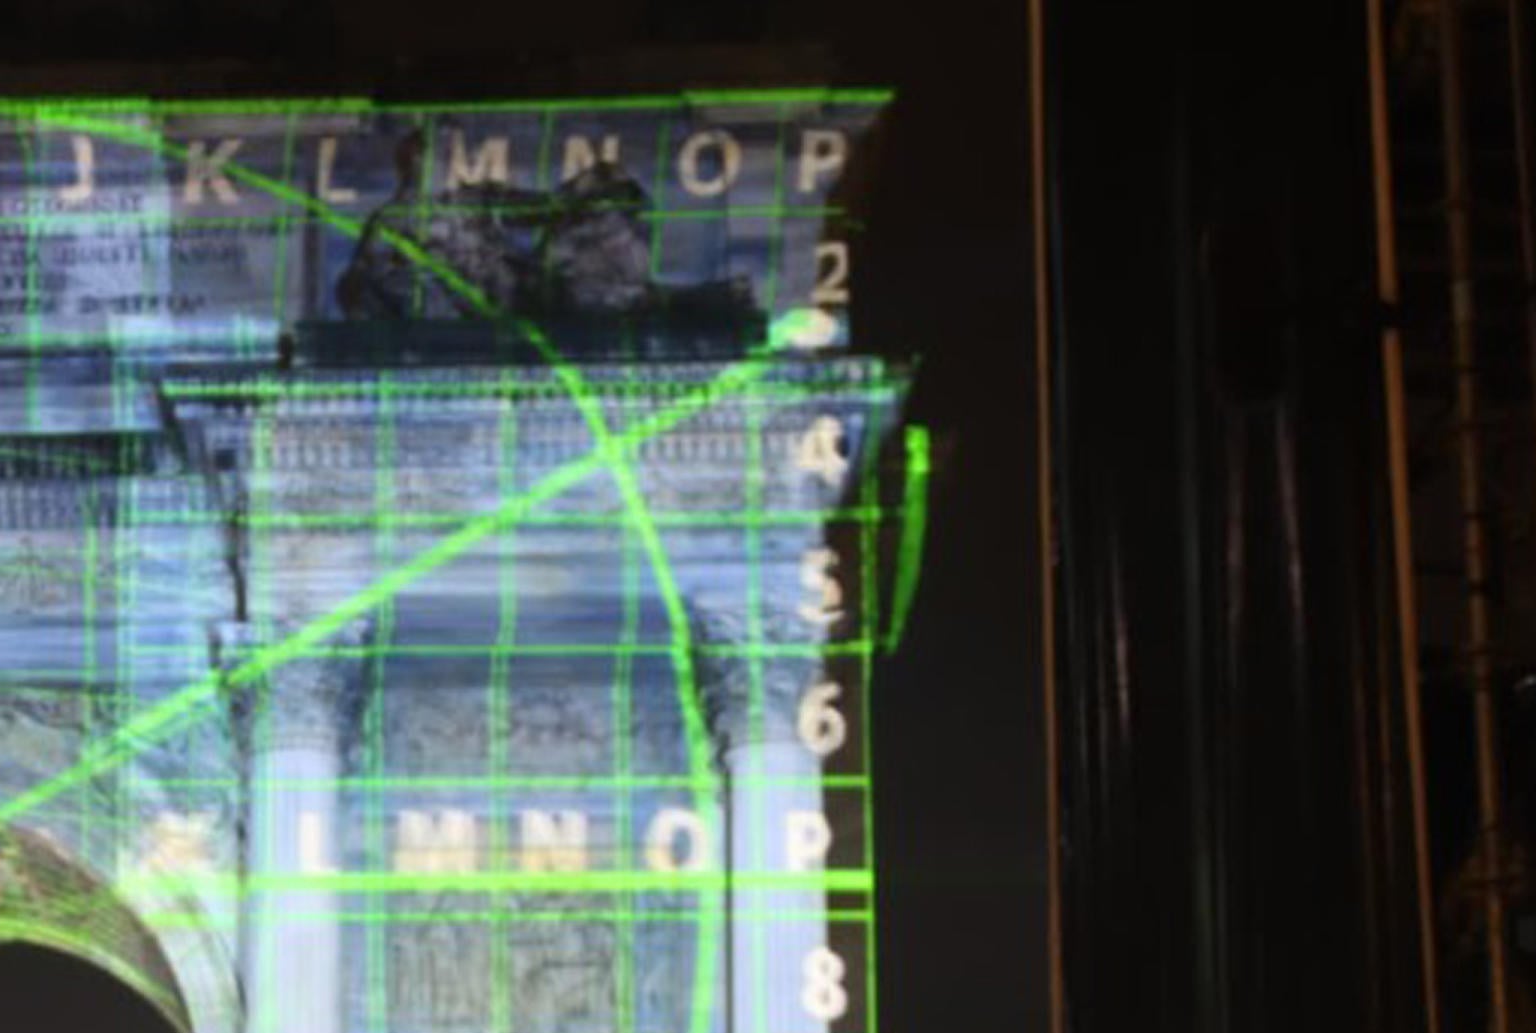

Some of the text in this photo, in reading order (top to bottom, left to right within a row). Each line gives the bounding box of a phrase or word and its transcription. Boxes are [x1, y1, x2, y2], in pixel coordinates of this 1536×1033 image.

[57, 134, 95, 202] J
[184, 137, 244, 205] K
[316, 136, 359, 202] L
[446, 128, 511, 192] M
[678, 130, 741, 197] O
[795, 129, 849, 192] P
[810, 241, 853, 303] 2
[798, 681, 848, 757] 6
[393, 809, 477, 875] M
[518, 809, 589, 875] N
[643, 807, 710, 876] O
[782, 809, 832, 875] P
[800, 945, 849, 1022] 8
